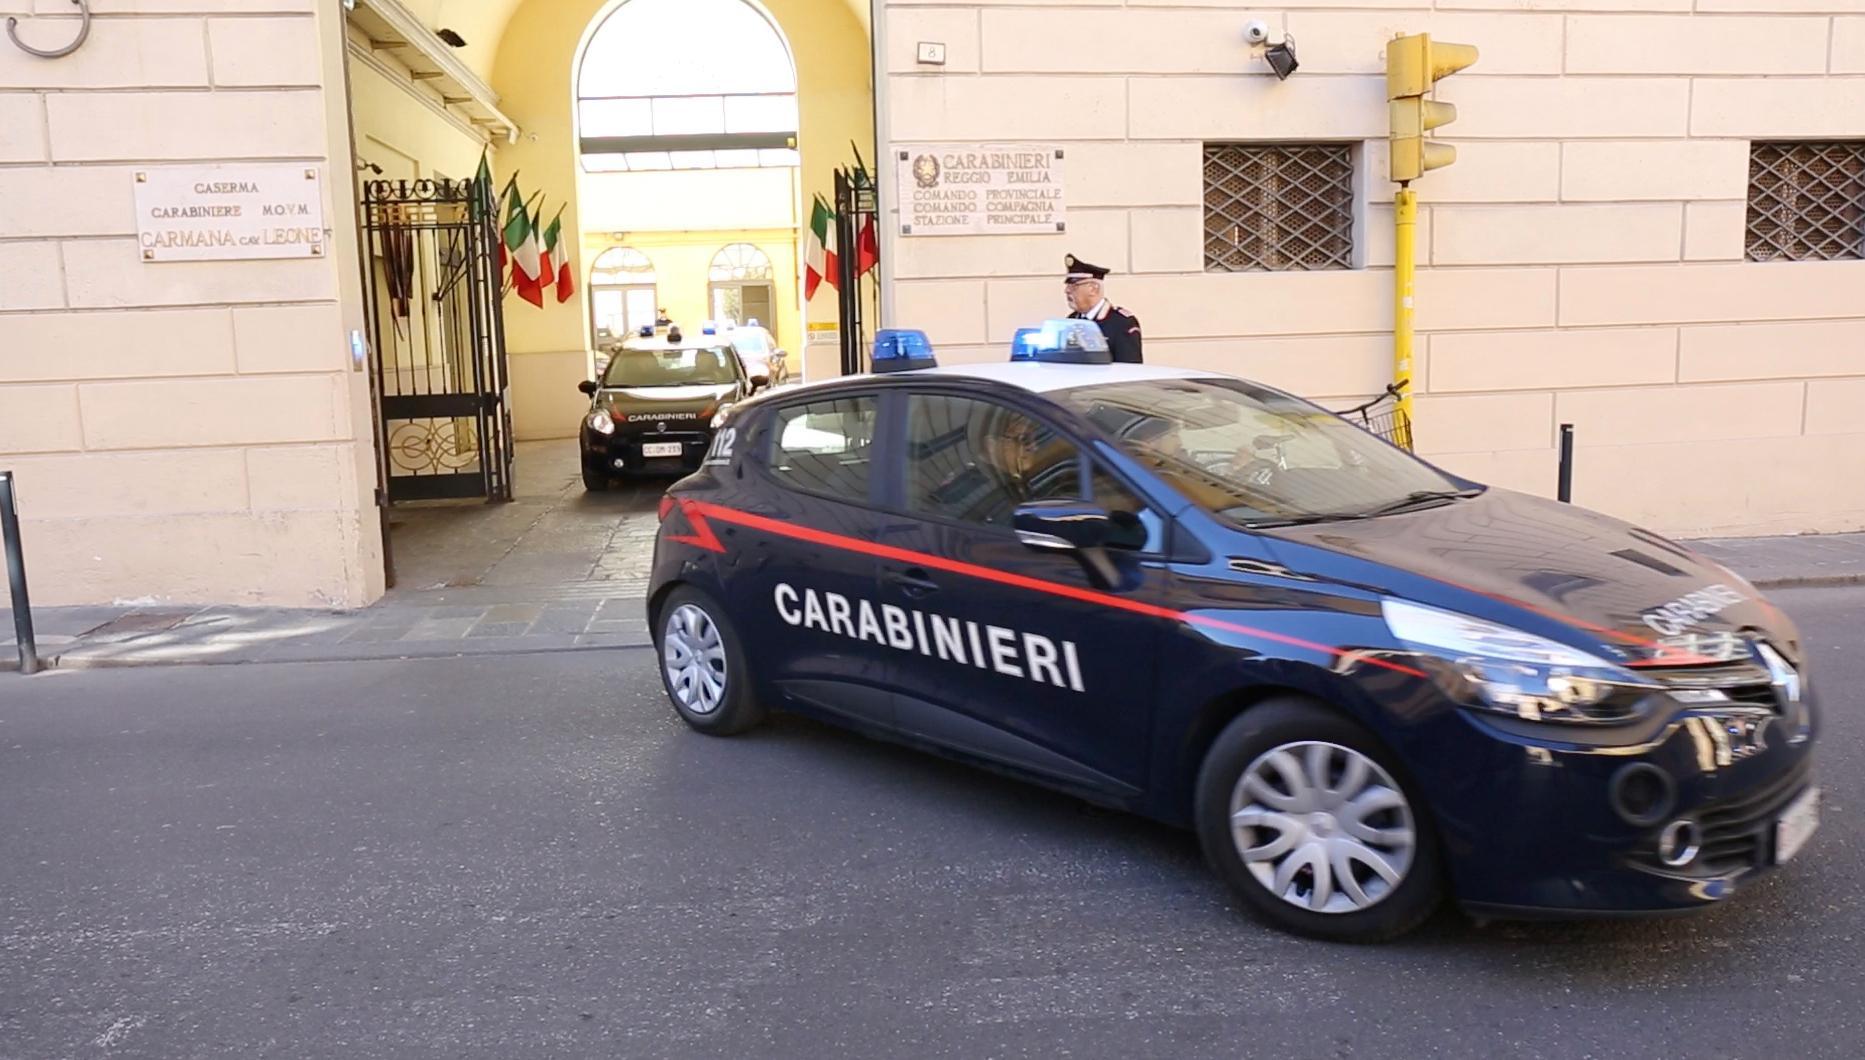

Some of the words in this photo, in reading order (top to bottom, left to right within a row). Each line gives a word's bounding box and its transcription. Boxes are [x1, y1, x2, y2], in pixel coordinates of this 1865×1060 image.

[928, 47, 936, 58] 8
[942, 153, 1051, 170] CARABINIERI
[944, 171, 991, 184] REGGIO
[1007, 171, 1052, 184] EMILIA
[194, 182, 260, 194] CASERMA
[913, 190, 977, 201] COMANDO
[986, 188, 1062, 200] PROVINCIALE
[151, 205, 242, 218] CARABINIERE
[913, 202, 977, 213] COMANDO
[985, 201, 1055, 213] COMPAGNIA
[913, 215, 970, 226] STAZIONE
[986, 214, 1053, 225] PRINCIPALE
[141, 229, 237, 248] CARMANA
[263, 227, 321, 245] LEONE
[628, 412, 697, 423] CARABINIERI
[711, 427, 736, 457] 112
[774, 582, 1086, 693] CARABINIERI
